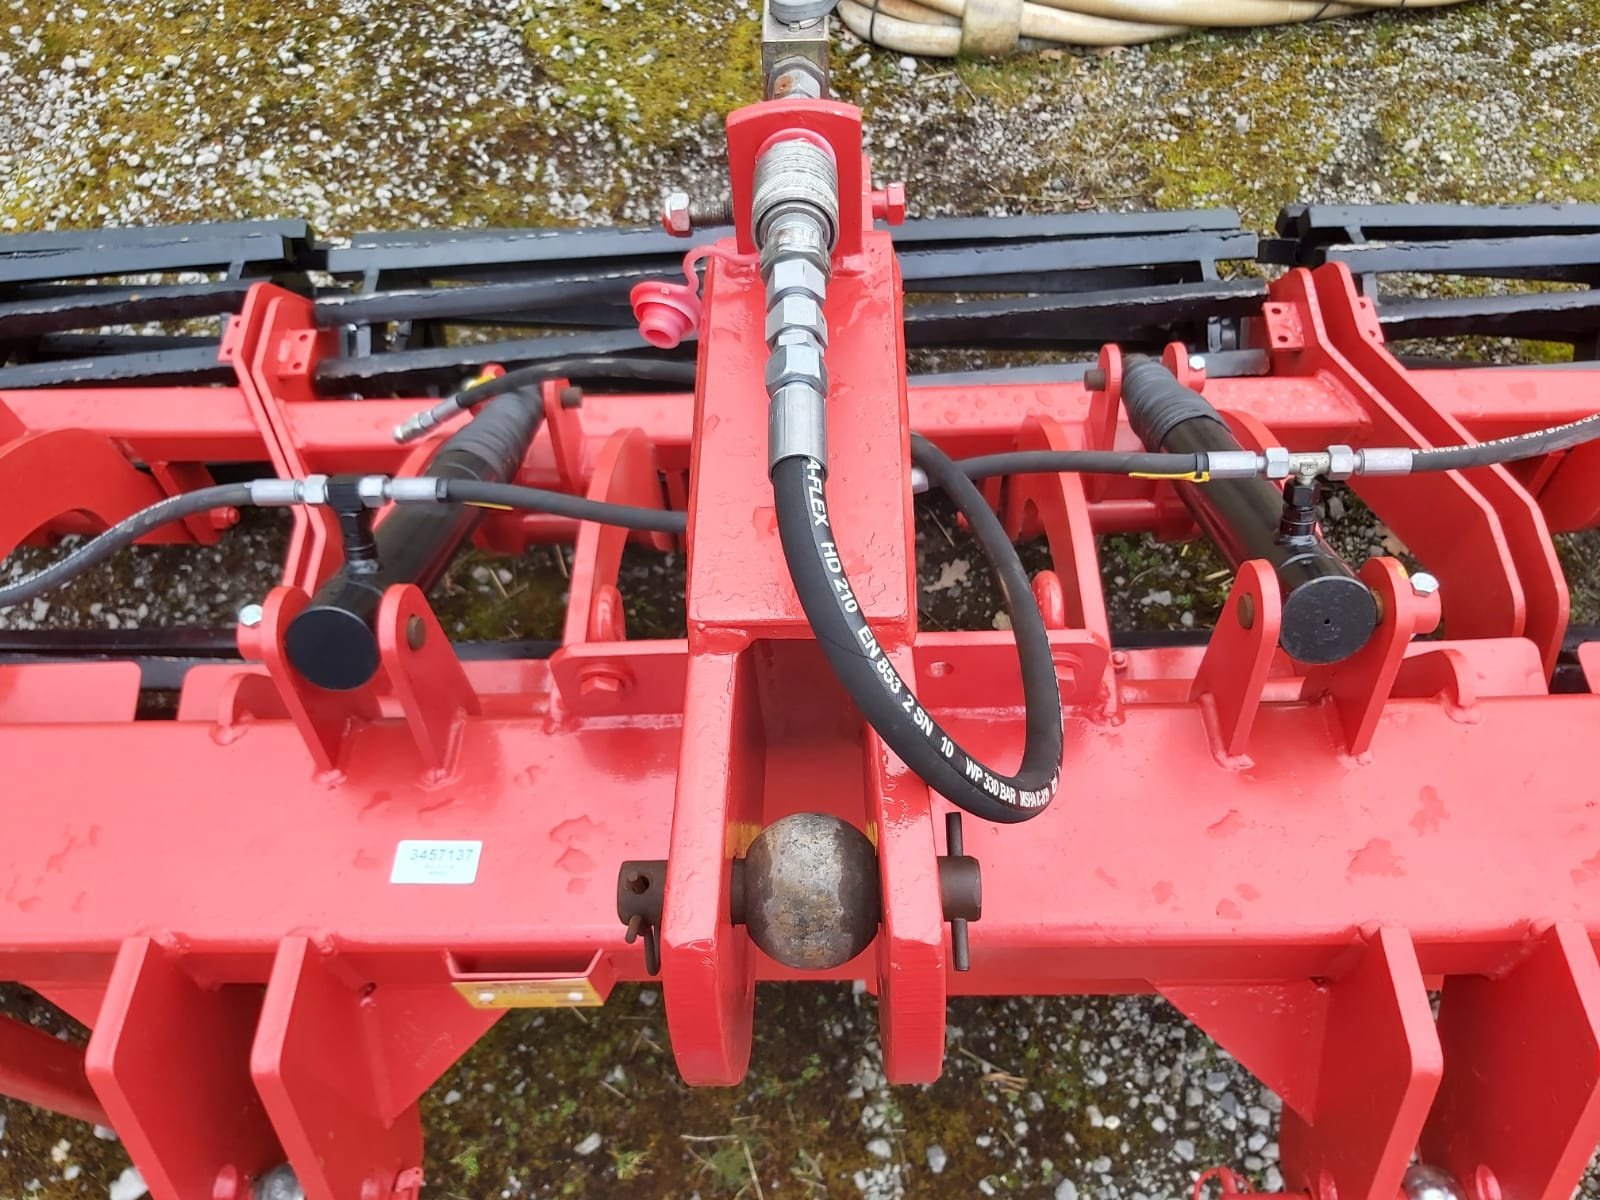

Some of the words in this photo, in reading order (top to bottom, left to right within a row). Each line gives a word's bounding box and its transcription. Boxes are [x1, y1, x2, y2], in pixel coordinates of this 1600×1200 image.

[820, 542, 842, 574] HD
[833, 577, 859, 613] 210
[857, 625, 881, 660] EN
[876, 659, 902, 694] 853
[901, 694, 915, 713] 2
[912, 707, 934, 737] SN
[940, 736, 955, 759] 10
[964, 756, 984, 783] WP
[982, 773, 1000, 796] 330
[998, 786, 1017, 806] BAR
